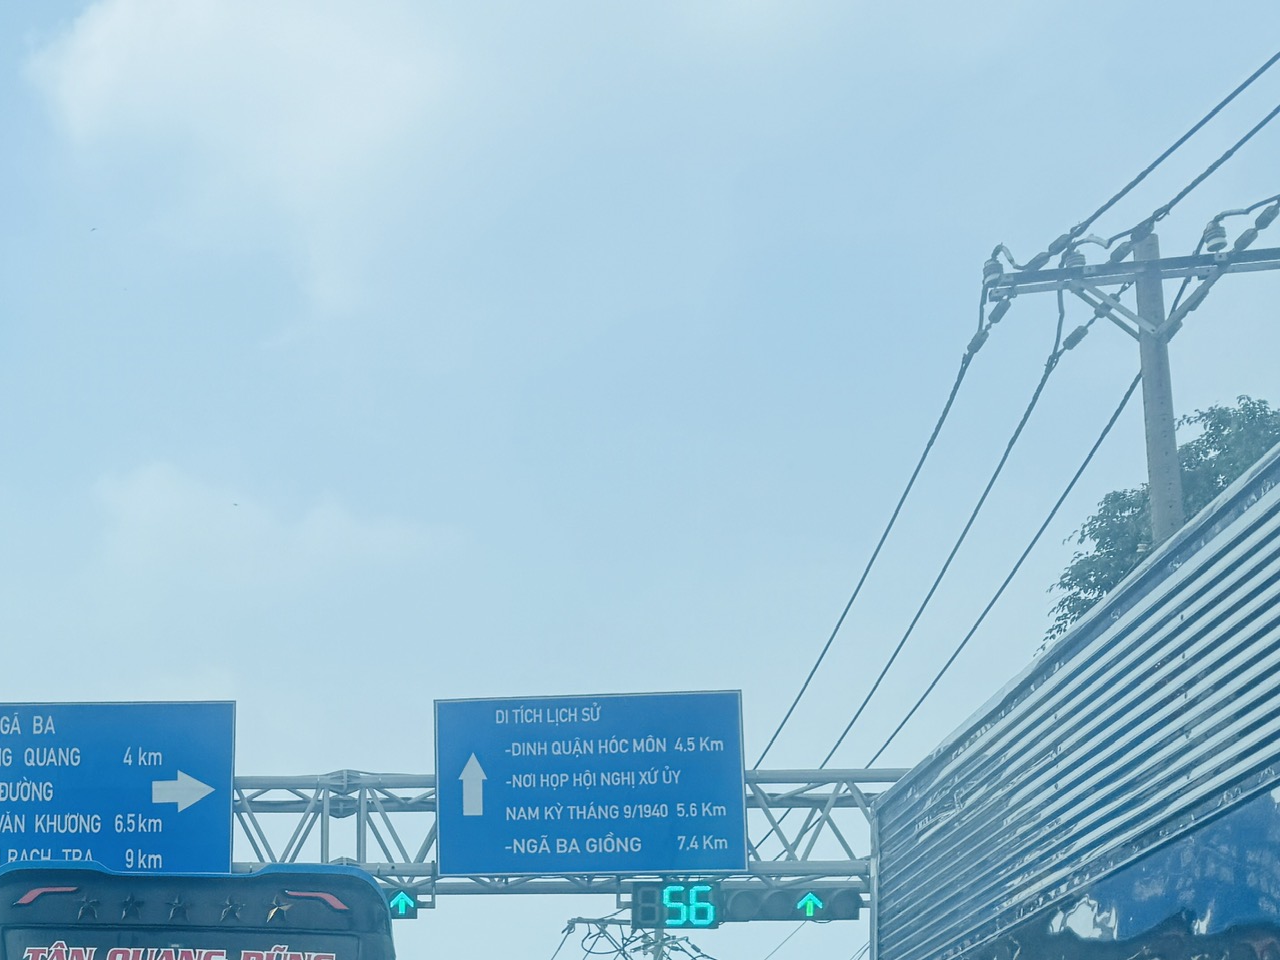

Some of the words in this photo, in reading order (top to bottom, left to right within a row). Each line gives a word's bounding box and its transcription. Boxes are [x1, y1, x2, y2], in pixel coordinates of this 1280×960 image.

[495, 709, 509, 724] DI
[512, 705, 542, 723] TÍCH
[547, 708, 577, 726] LỊCH
[581, 702, 602, 722] SỬ
[32, 715, 56, 735] BA
[123, 747, 133, 766] 4
[138, 747, 162, 766] km
[551, 737, 594, 758] QUẬN
[598, 735, 629, 754] HÓC
[632, 735, 667, 752] MÔN
[674, 737, 695, 752] 4.5
[699, 736, 724, 752] Km
[24, 747, 81, 768] QUANG
[540, 773, 569, 790] HỌP
[573, 771, 596, 790] HỘI
[600, 771, 636, 789] NGHỊ
[638, 767, 659, 785] XỨ
[662, 765, 681, 784] ỦY
[505, 806, 540, 821] NAM
[544, 802, 564, 820] KỲ
[567, 801, 619, 820] THÁNG
[623, 804, 668, 819] 9/1940
[676, 803, 697, 818] 5.6
[701, 803, 727, 817] Km
[35, 812, 101, 834] KHƯƠNG
[114, 814, 136, 833] 6.5
[138, 813, 162, 832] km
[556, 838, 581, 854] BA
[585, 831, 642, 852] GIỒNG
[677, 836, 698, 851] 7.4
[702, 835, 728, 850] Km
[125, 849, 134, 869] 9
[138, 848, 162, 868] km
[663, 885, 715, 925] 56
